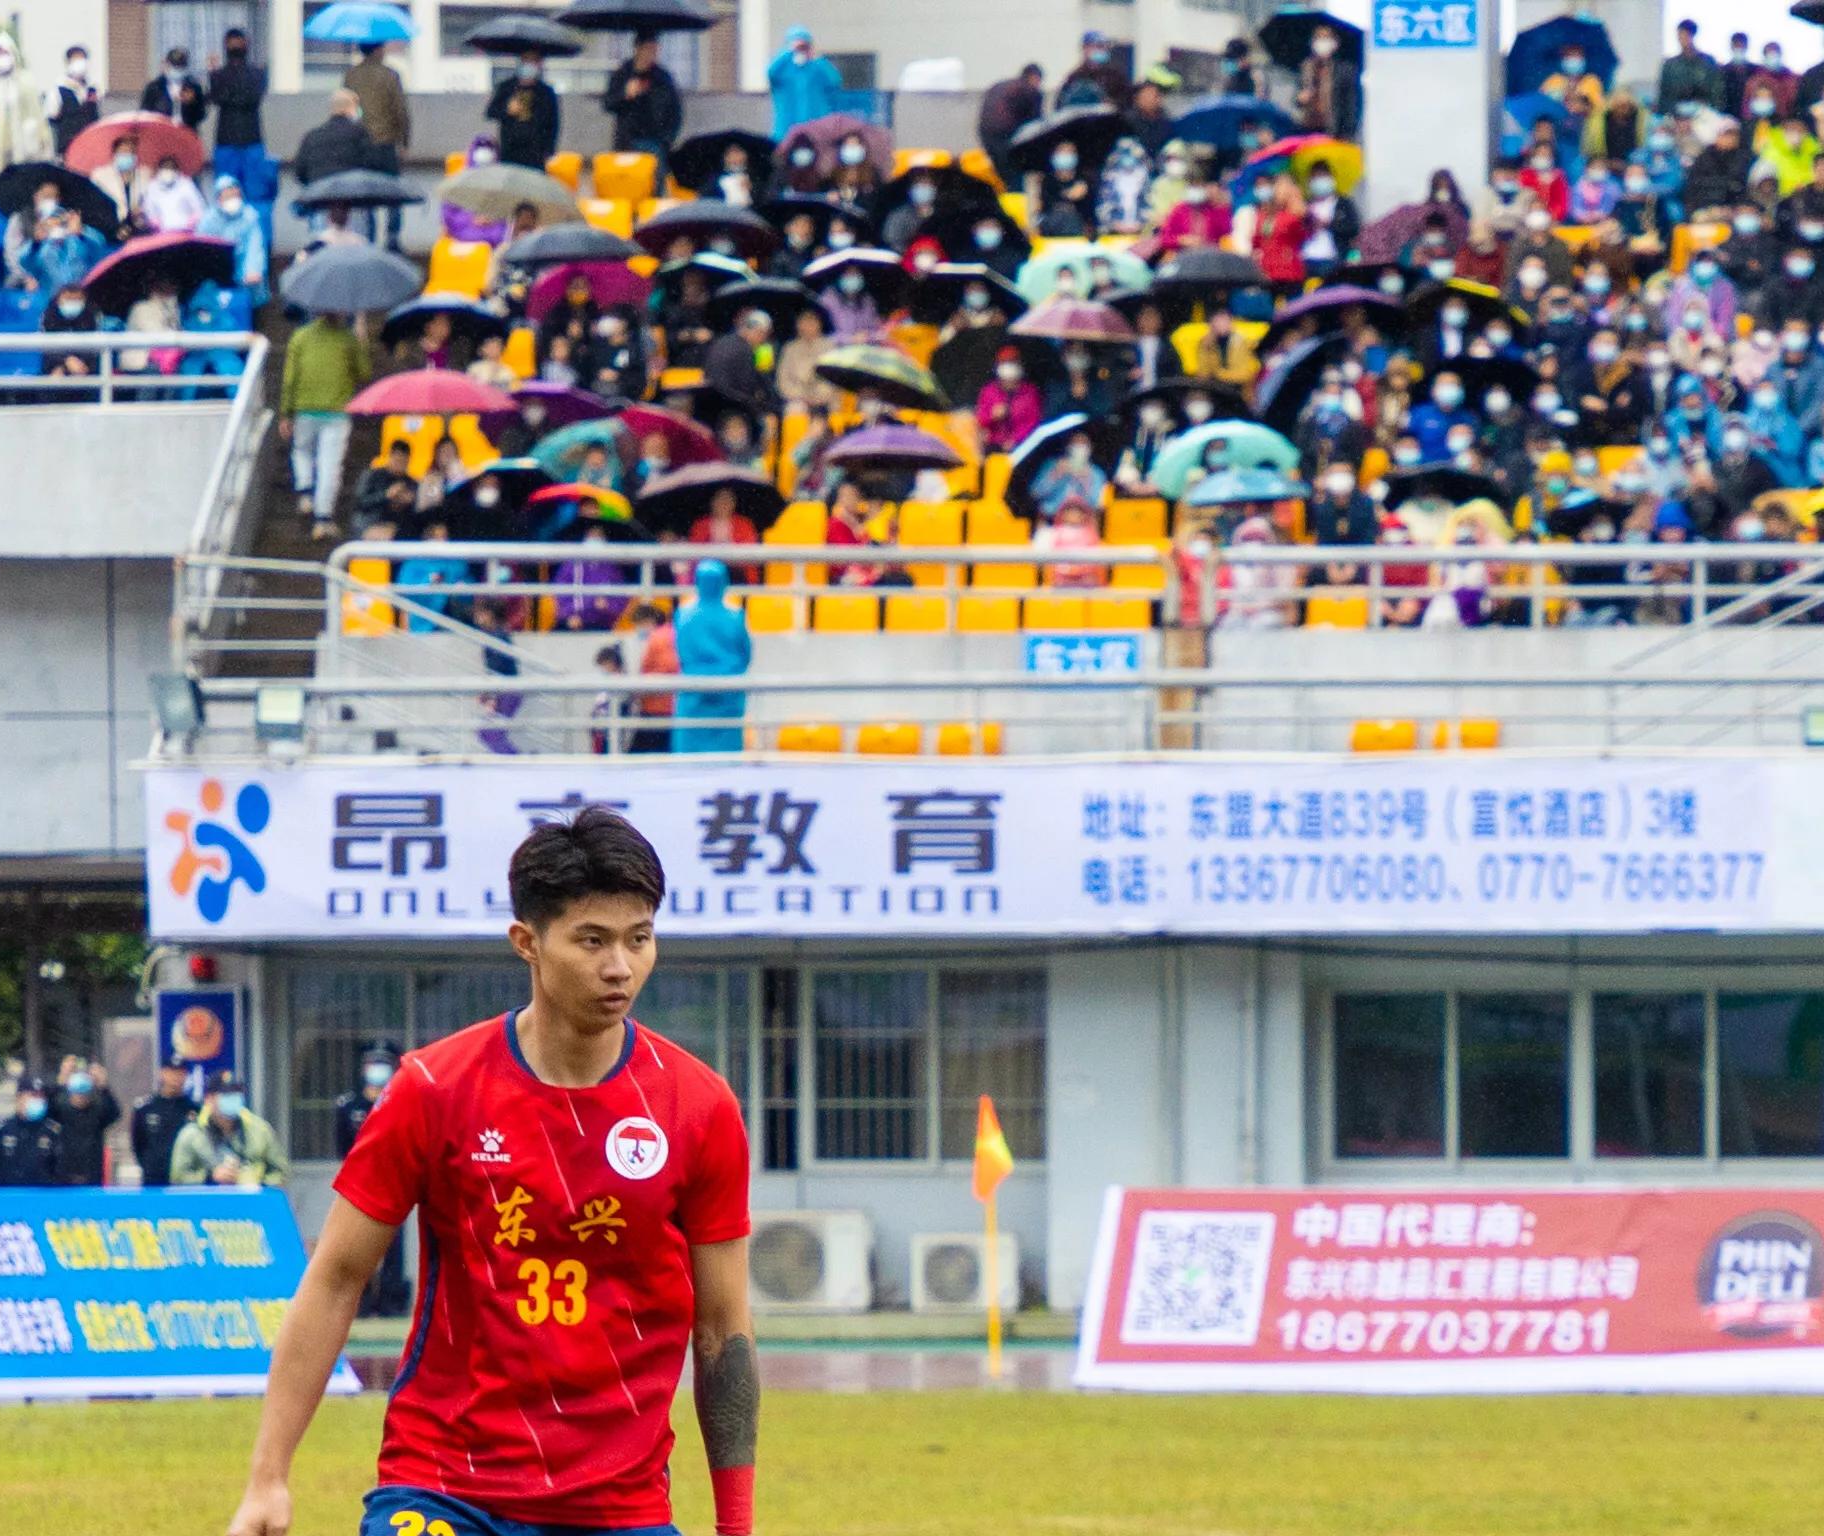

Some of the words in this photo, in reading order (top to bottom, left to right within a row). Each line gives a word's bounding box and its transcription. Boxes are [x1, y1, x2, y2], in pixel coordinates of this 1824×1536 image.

[1379, 4, 1473, 43] 东六区
[669, 886, 1000, 916] UCATION
[471, 1153, 511, 1164] KELME
[493, 1186, 627, 1246] 东兴
[1720, 1239, 1813, 1271] PHIN
[516, 1258, 588, 1326] 33
[1714, 1270, 1808, 1303] DELI
[1278, 1308, 1610, 1353] 18677037781
